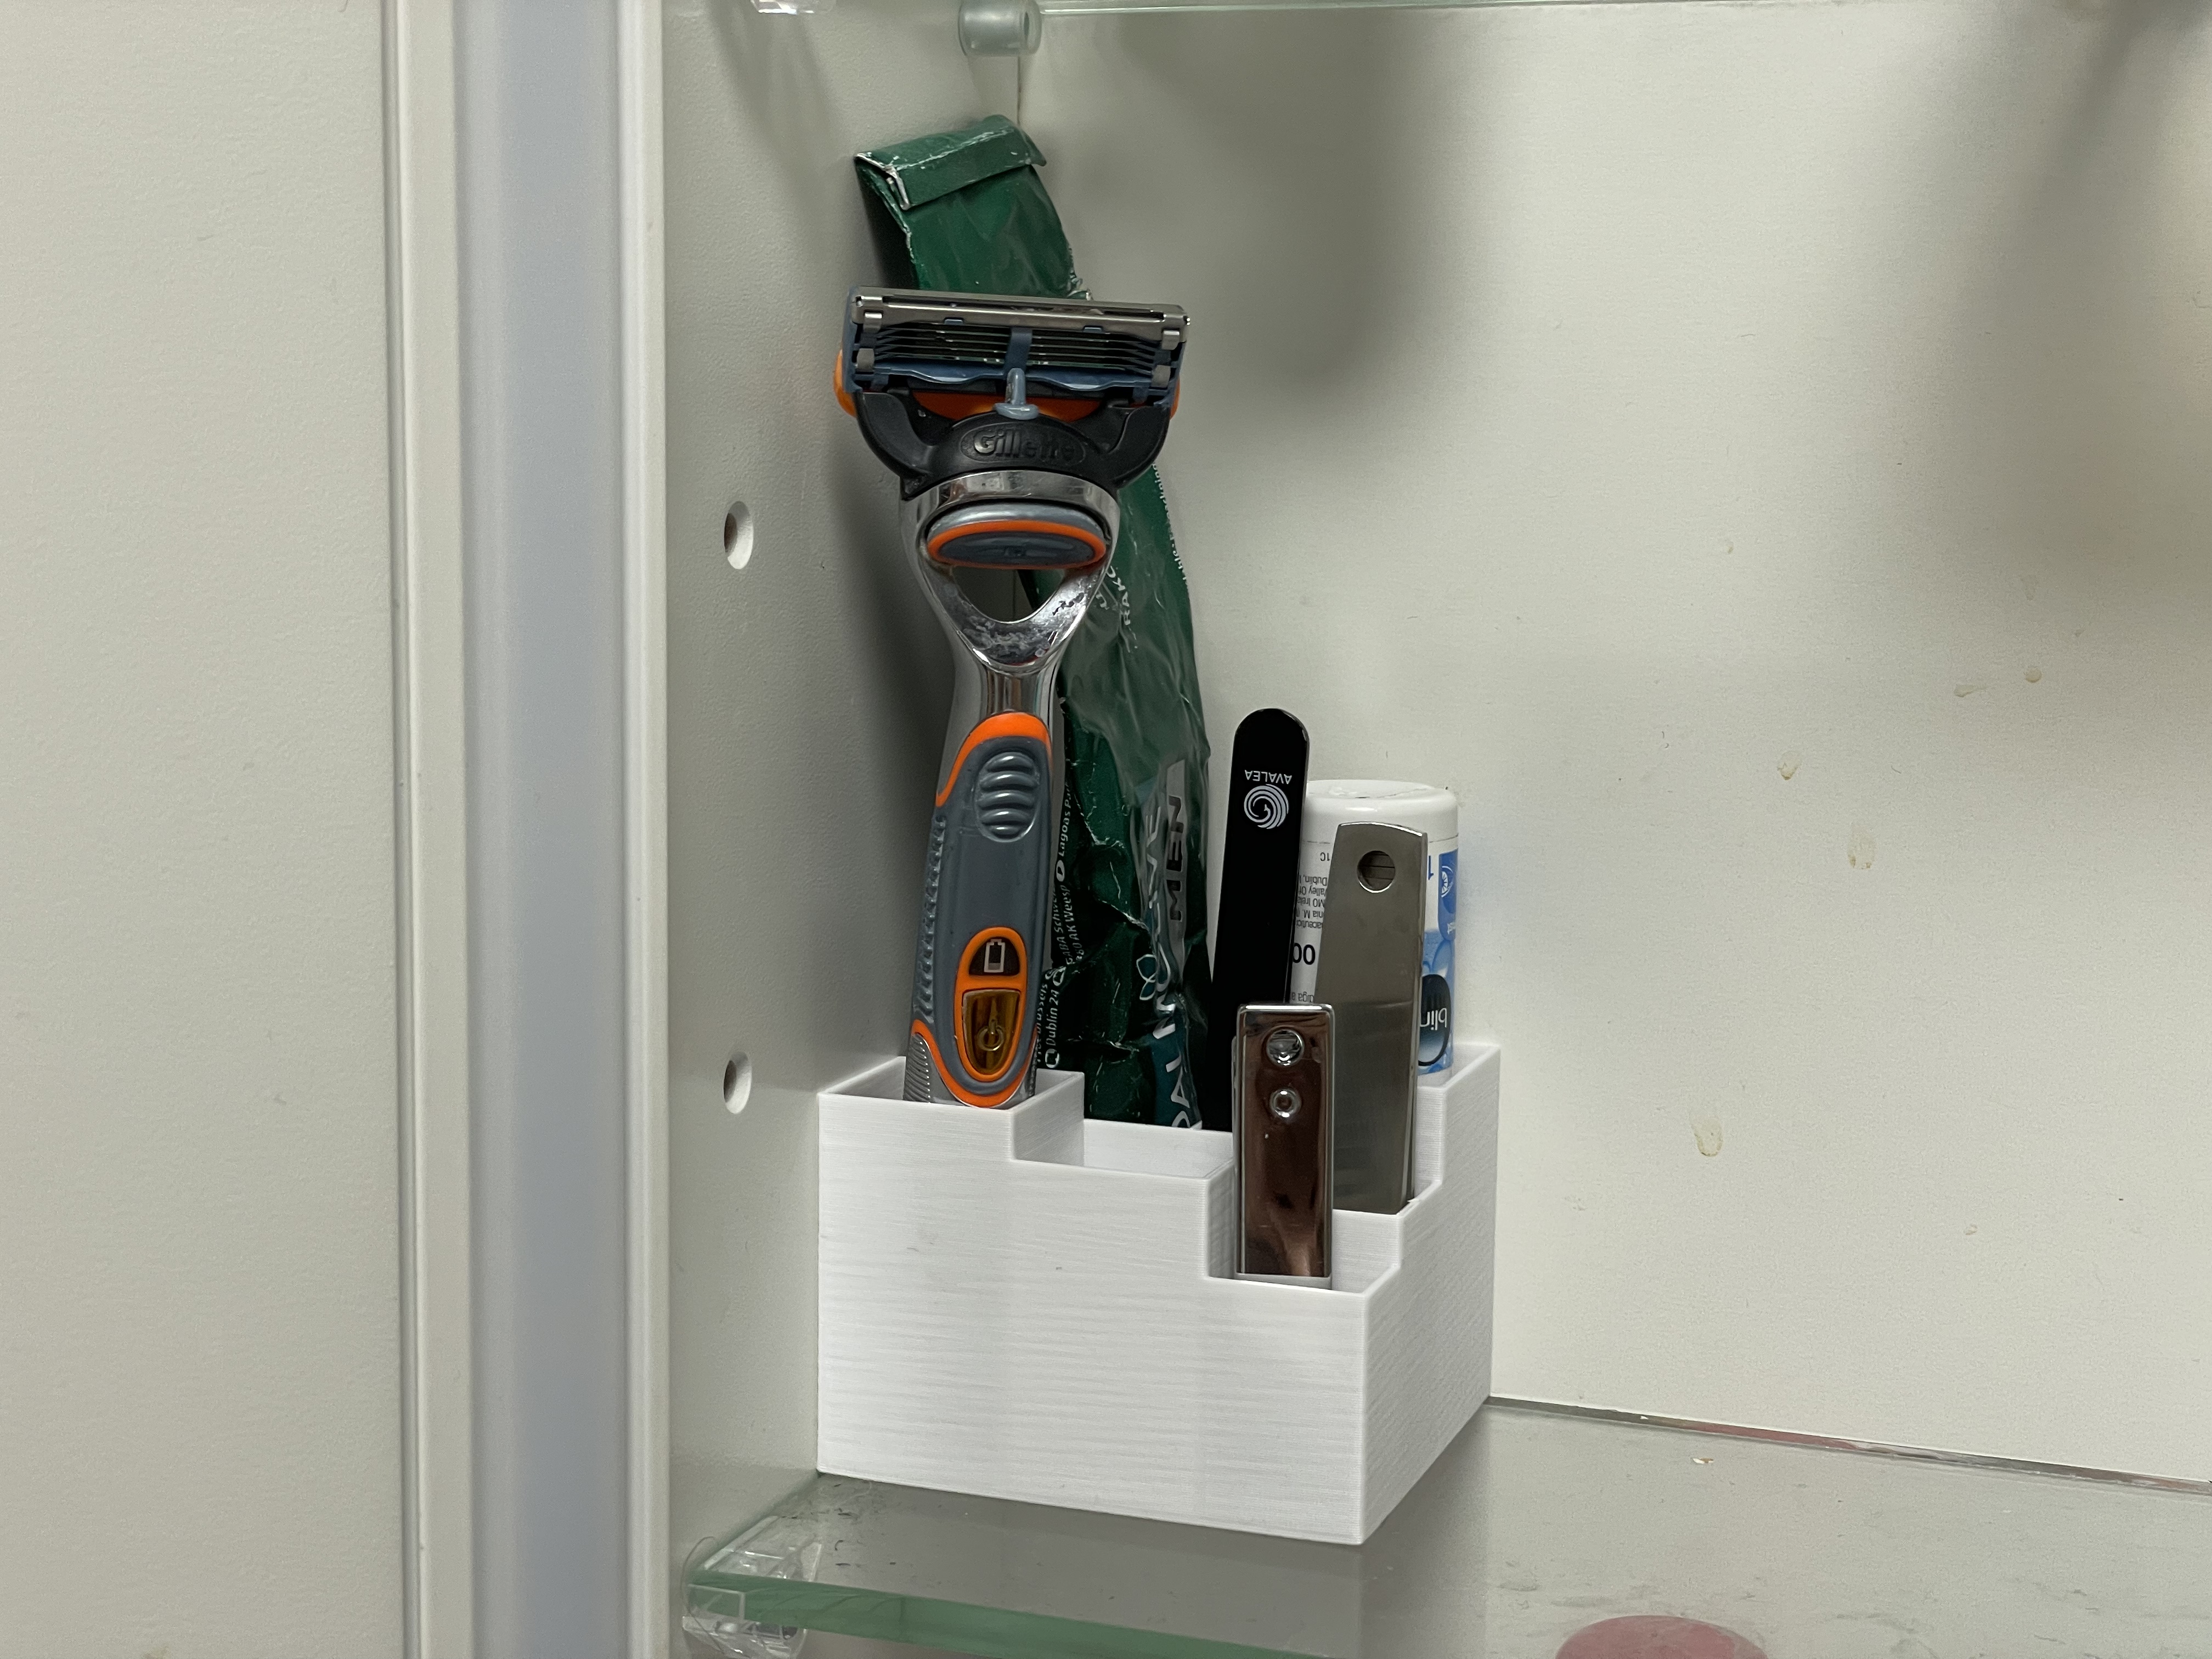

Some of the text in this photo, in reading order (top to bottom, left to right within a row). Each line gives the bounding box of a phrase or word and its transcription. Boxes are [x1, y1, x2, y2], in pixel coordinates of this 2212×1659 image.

[1244, 770, 1293, 785] AVALEA
[1166, 795, 1184, 922] MEN
[1320, 852, 1330, 861] 1C
[1308, 885, 1325, 896] alley
[1060, 885, 1075, 922] Weesp
[1066, 925, 1080, 940] AK
[1057, 936, 1073, 964] GABA
[1046, 1007, 1058, 1046] Dublin
